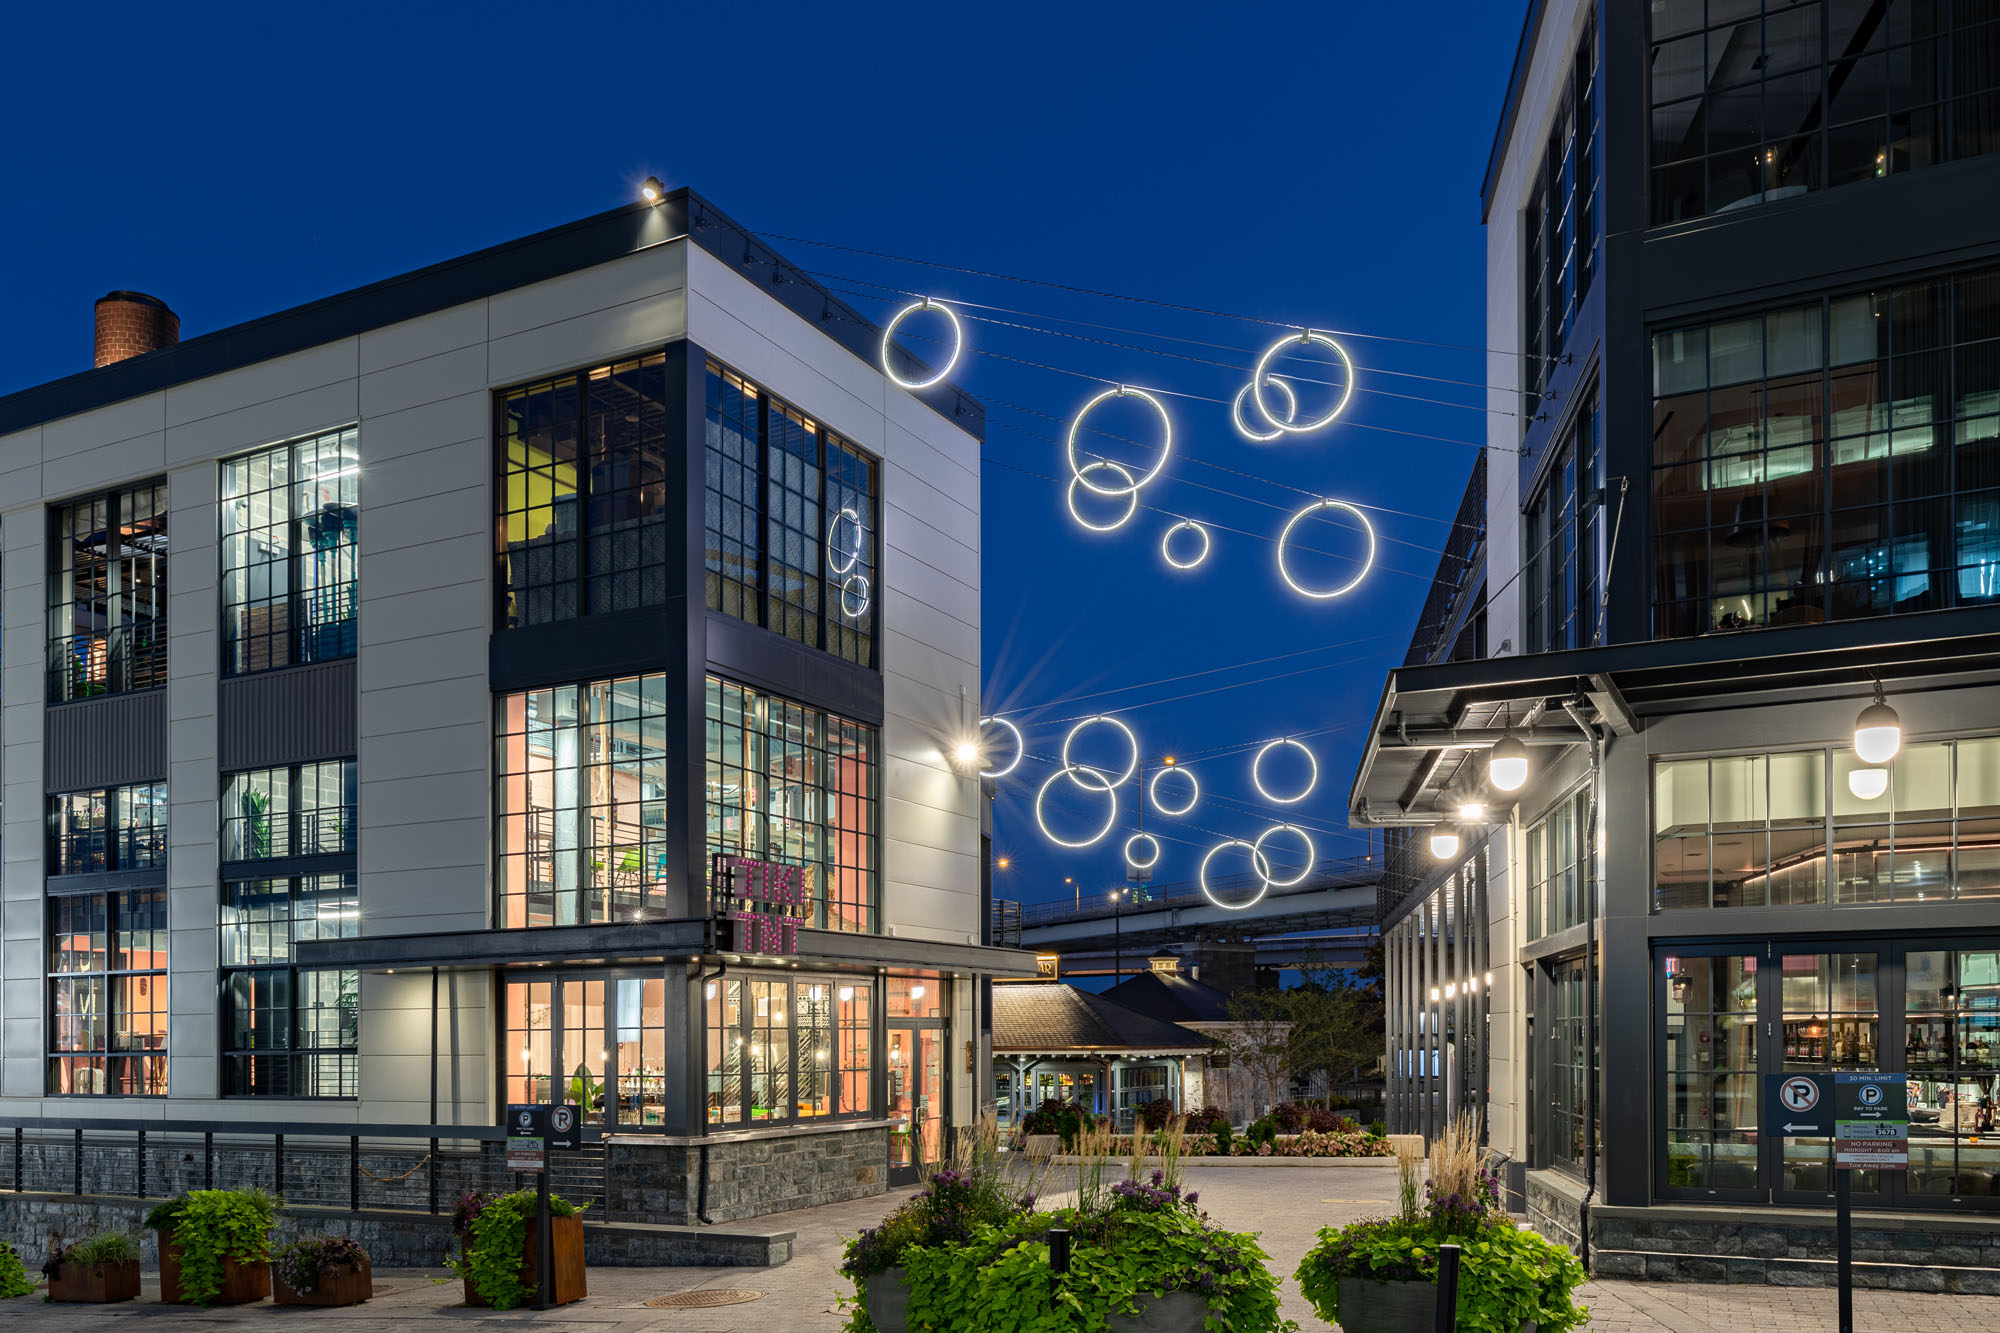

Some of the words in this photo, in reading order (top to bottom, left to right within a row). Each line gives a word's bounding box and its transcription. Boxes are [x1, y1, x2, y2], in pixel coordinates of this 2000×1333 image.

[735, 857, 804, 905] TIKI
[735, 912, 804, 956] TNT
[1866, 1089, 1877, 1101] P
